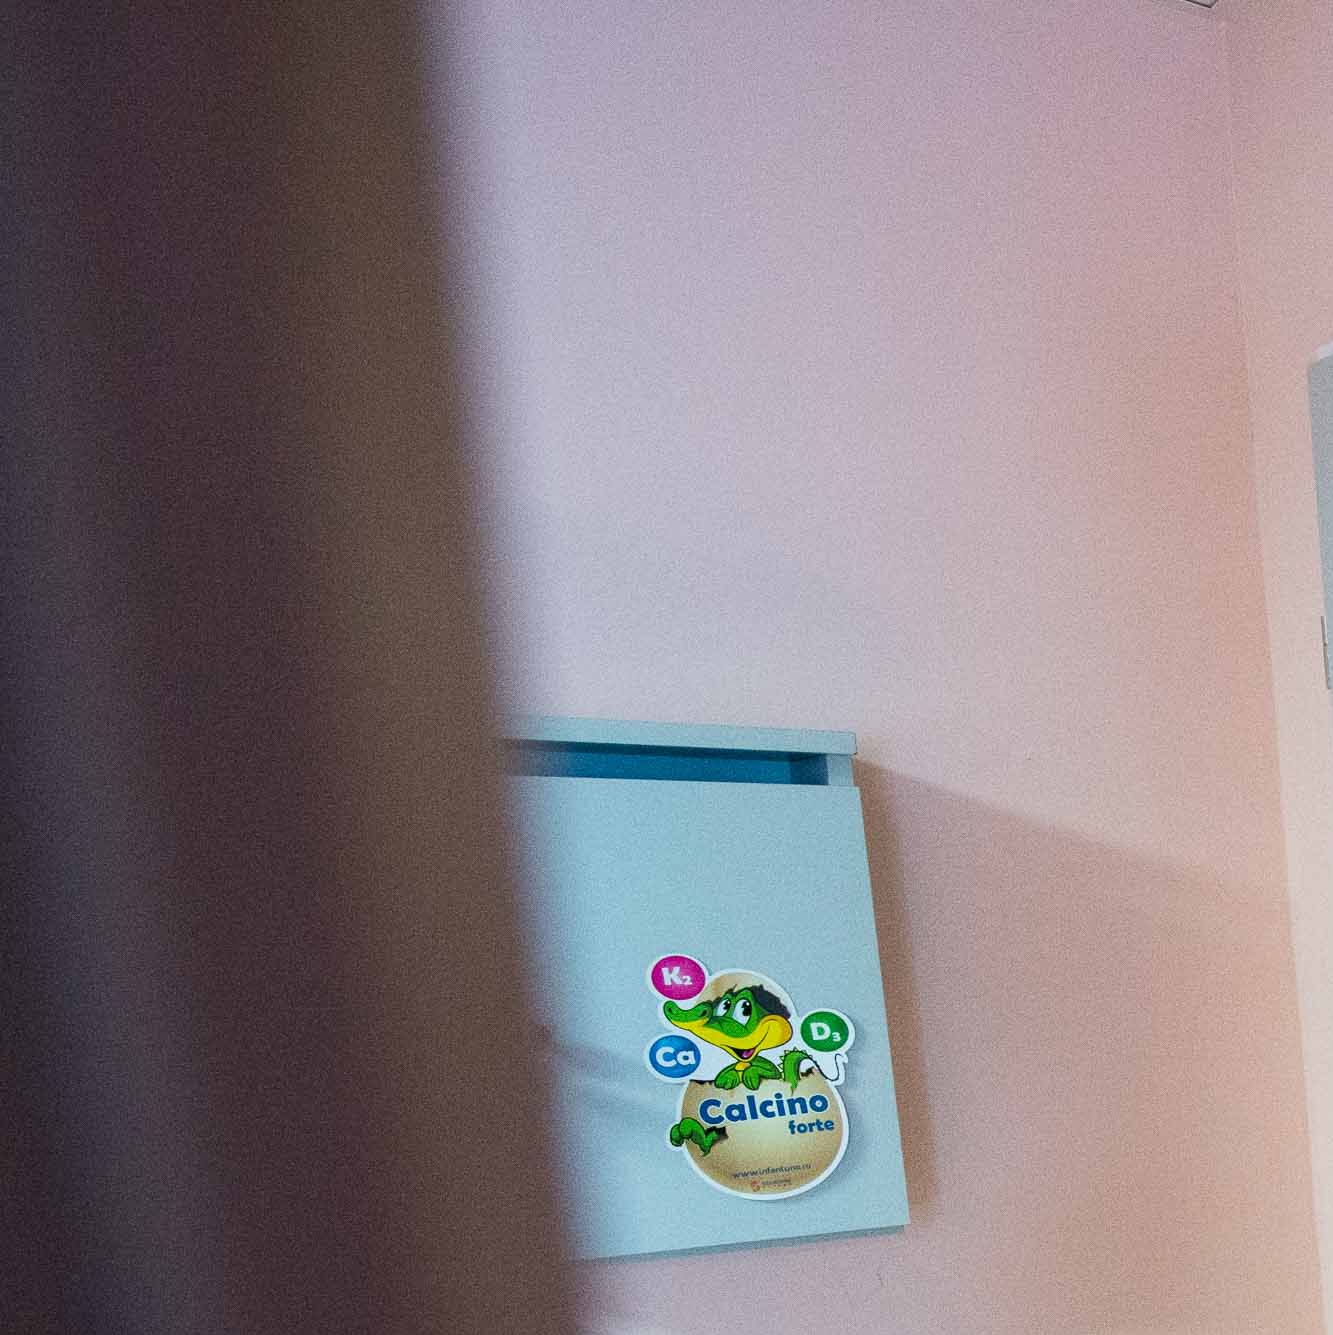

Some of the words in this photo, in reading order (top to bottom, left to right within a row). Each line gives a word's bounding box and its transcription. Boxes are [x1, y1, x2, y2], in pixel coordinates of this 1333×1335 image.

[661, 966, 693, 987] K2
[809, 1021, 841, 1043] D3
[654, 1046, 697, 1068] Ca
[699, 1093, 829, 1125] Calcino
[787, 1118, 835, 1135] forte
